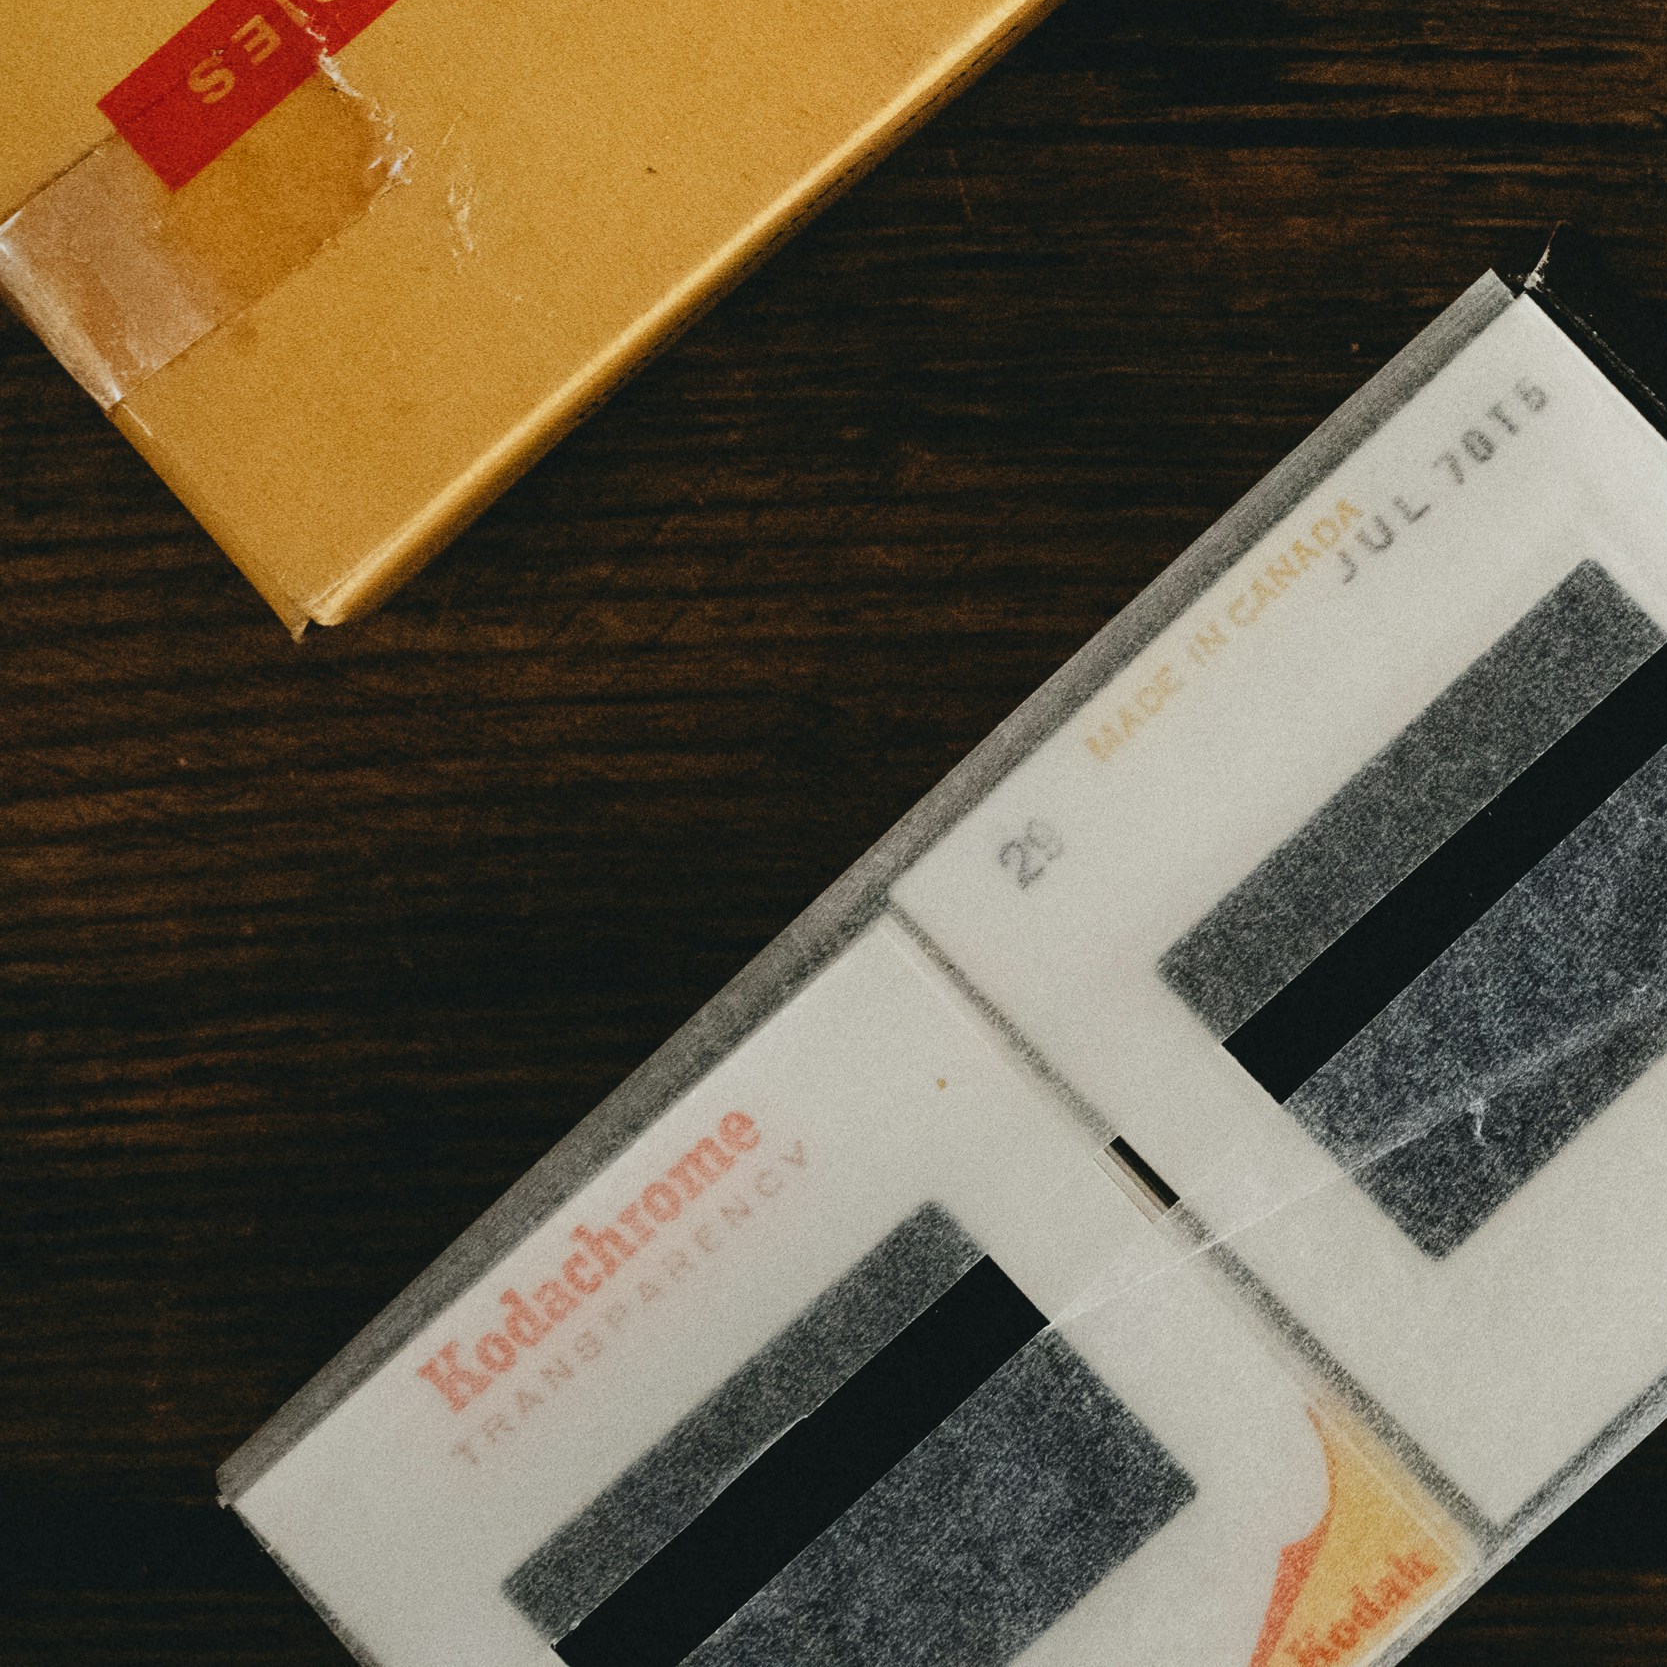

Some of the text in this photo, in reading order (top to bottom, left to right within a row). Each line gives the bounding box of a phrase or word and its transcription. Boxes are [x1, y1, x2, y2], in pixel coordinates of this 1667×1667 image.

[1084, 497, 1366, 763] MADE IN CANADA
[1337, 493, 1431, 584] JUL
[417, 1110, 763, 1413] Kodachrome
[450, 1138, 812, 1468] TRANSPARENCY
